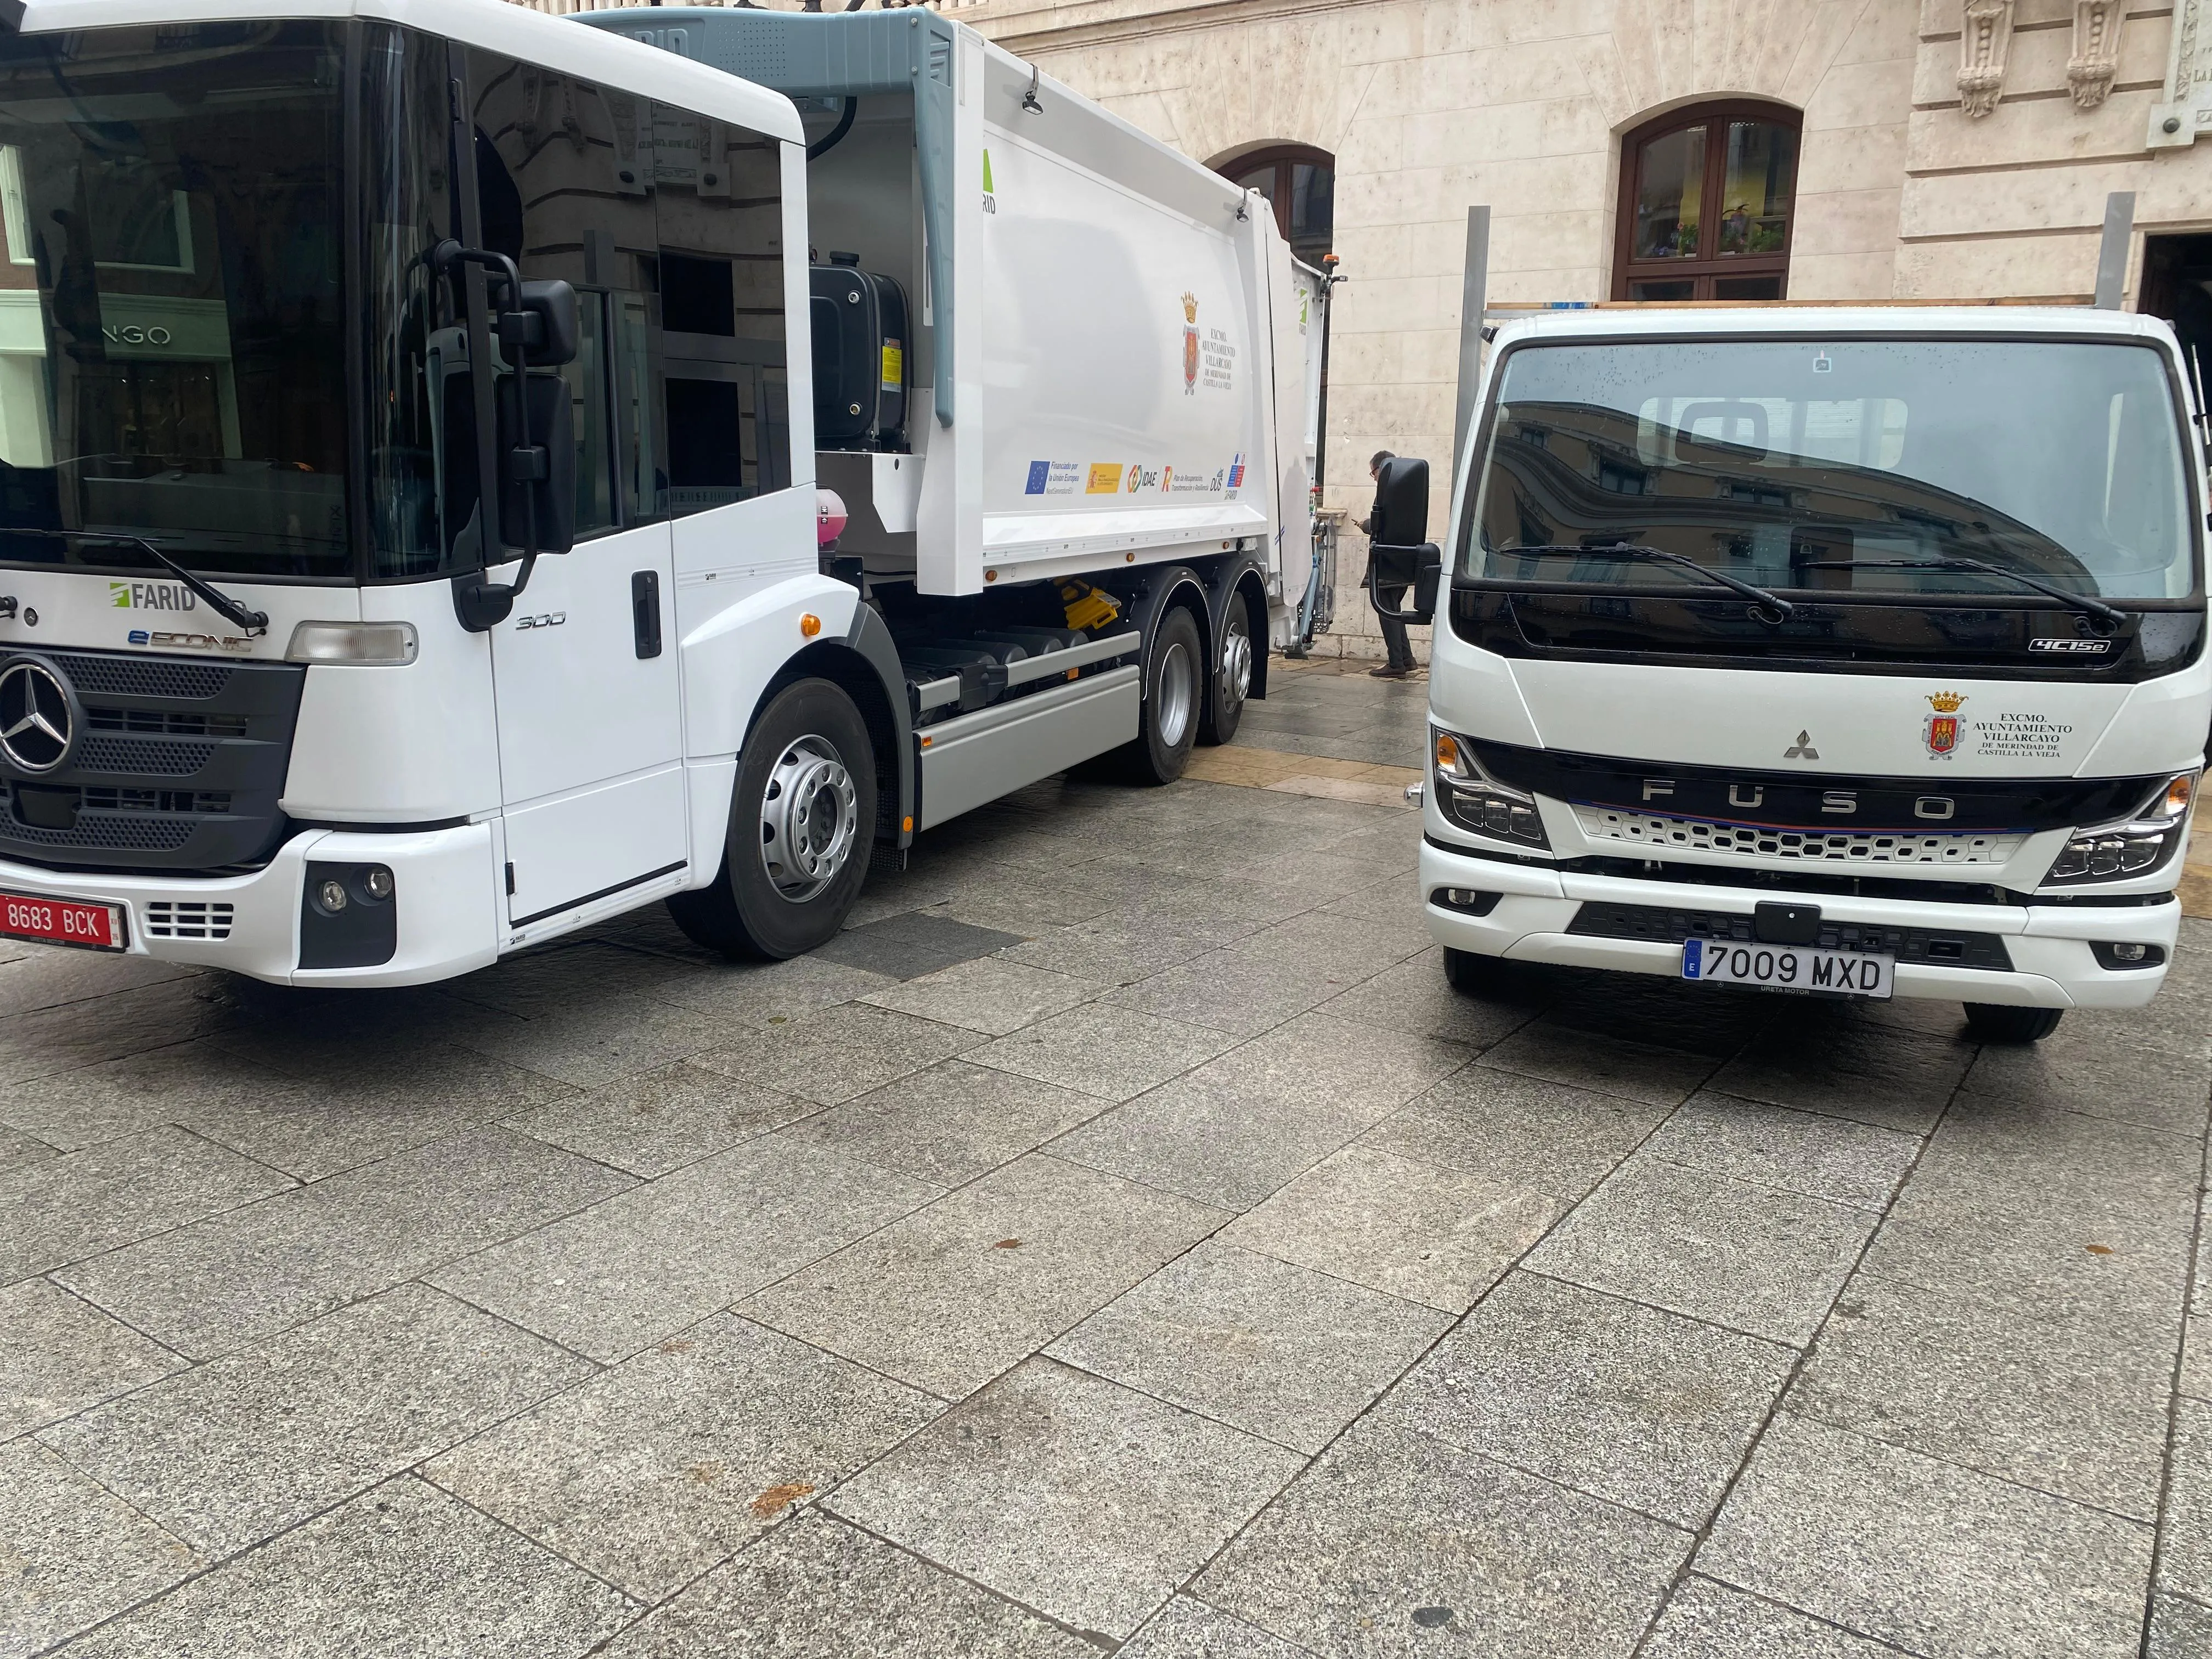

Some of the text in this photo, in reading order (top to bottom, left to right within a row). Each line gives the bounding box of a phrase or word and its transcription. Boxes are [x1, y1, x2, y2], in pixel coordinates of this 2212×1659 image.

[1202, 340, 1235, 358] AYUNTAMIENTO
[1206, 354, 1232, 370] VILLARCAYO
[1203, 377, 1218, 388] CASTILLA
[1051, 461, 1079, 471] Financiado por
[1064, 474, 1079, 483] Europea
[1142, 472, 1157, 487] IDAE
[1210, 477, 1223, 492] DUS
[132, 584, 196, 611] FARID
[515, 611, 567, 630] 300
[2037, 641, 2104, 651] 4C15e
[2001, 713, 2047, 723] EXCMO.
[1973, 723, 2073, 733] AYUNTAMIENTO
[1984, 733, 2060, 743] VILLARCAYO
[1997, 742, 2044, 751] MERINDAD
[1643, 779, 1955, 820] FUSO
[8, 904, 99, 937] 8683 BCK
[1689, 962, 1695, 972] E
[1707, 946, 1881, 991] 7009 MXD
[1784, 988, 1810, 996] MOTOR
